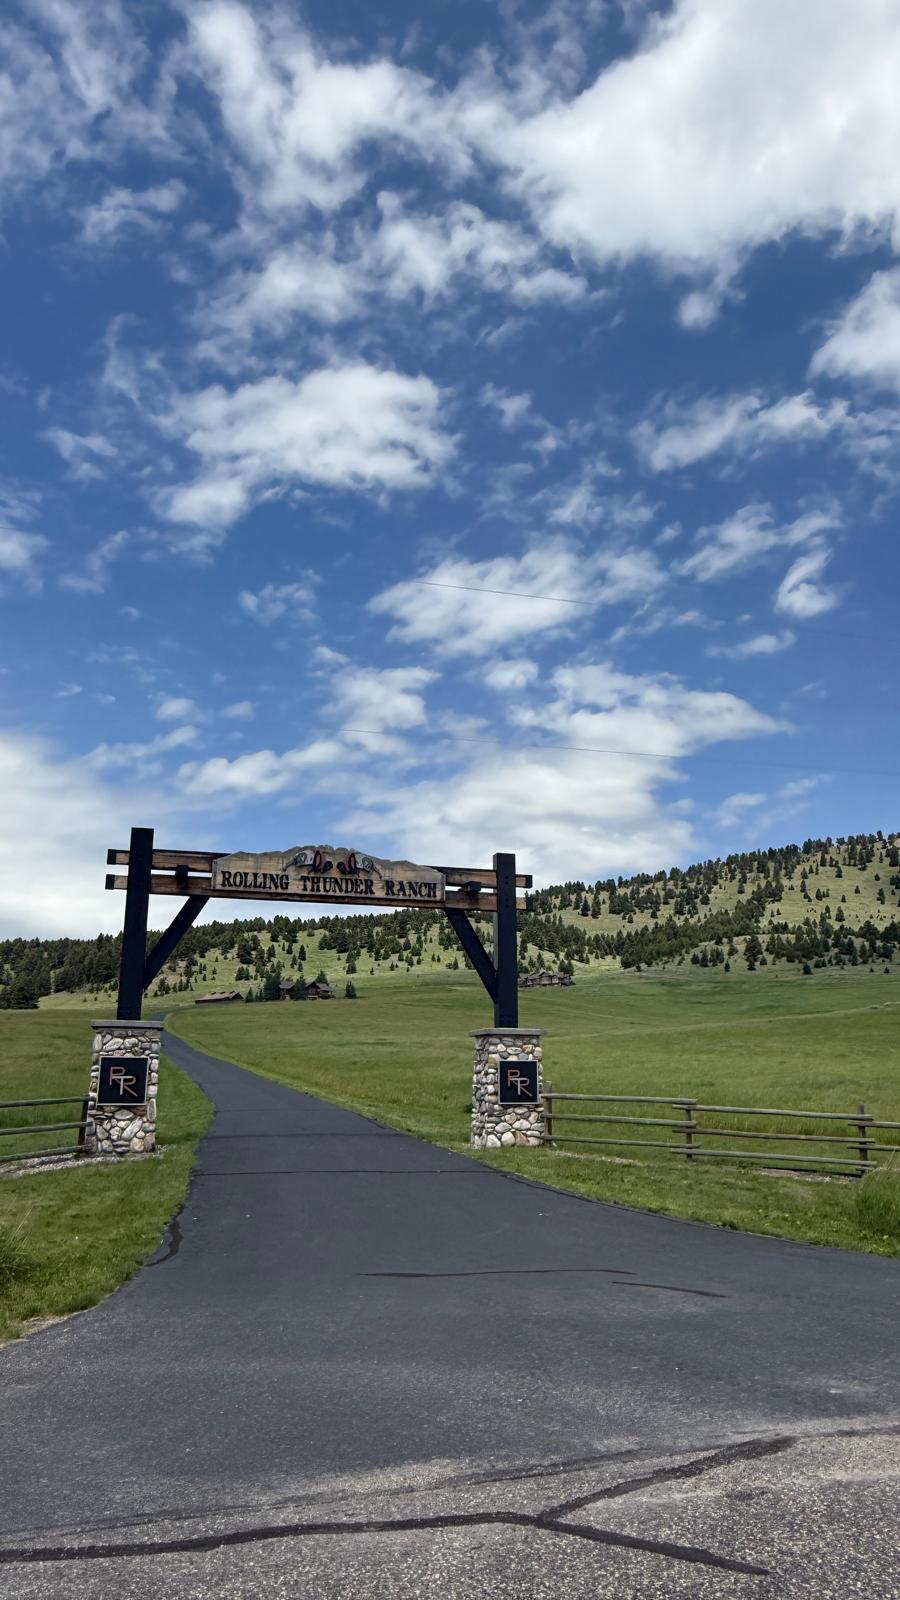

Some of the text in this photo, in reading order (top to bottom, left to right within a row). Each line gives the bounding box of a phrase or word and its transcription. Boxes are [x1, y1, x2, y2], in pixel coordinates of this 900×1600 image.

[221, 870, 437, 898] ROLLING THUNDER RANCH
